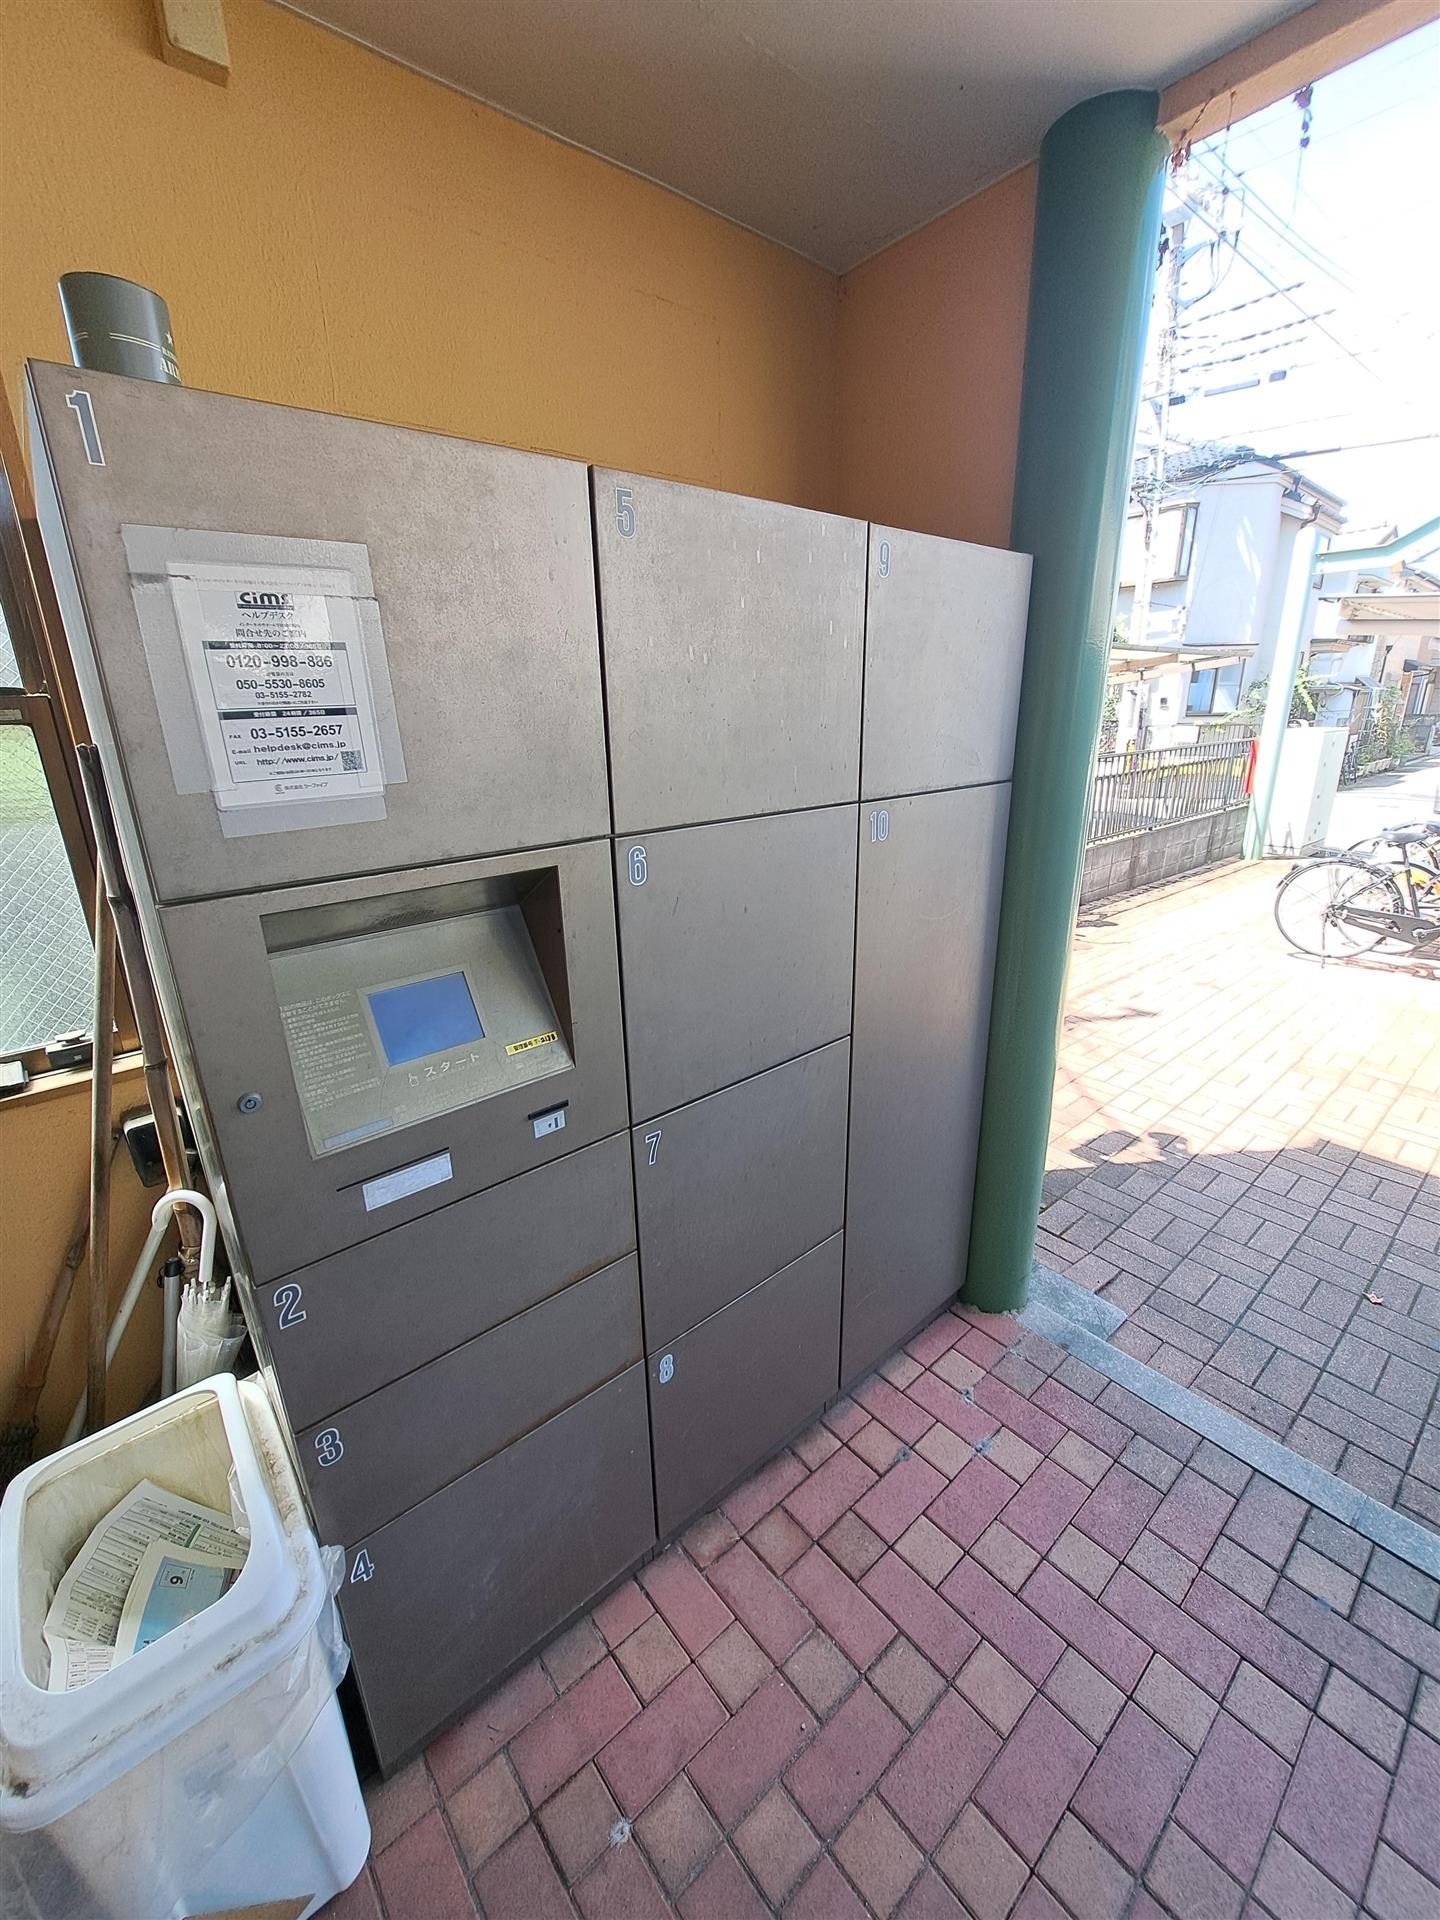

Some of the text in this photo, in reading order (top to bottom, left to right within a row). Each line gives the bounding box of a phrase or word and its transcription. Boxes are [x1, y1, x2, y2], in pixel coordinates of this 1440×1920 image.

[65, 389, 106, 467] 1
[615, 487, 637, 539] 5
[878, 540, 891, 579] 9
[239, 591, 290, 605] cims
[241, 610, 294, 620] ヘルプデスク
[225, 654, 333, 668] 0120-998-886
[235, 678, 326, 690] 050-5530-8605
[255, 690, 312, 699] 03-5155-2782
[250, 724, 343, 740] 03-5155-2657
[253, 740, 347, 753] helpdesk@cims.jp
[869, 810, 889, 843] 10
[628, 845, 647, 886] 6
[423, 1052, 480, 1078] スタート
[645, 1130, 662, 1166] 7
[273, 1283, 307, 1330] 2
[660, 1353, 674, 1384] 8
[315, 1427, 344, 1467] 3
[350, 1548, 375, 1584] 4
